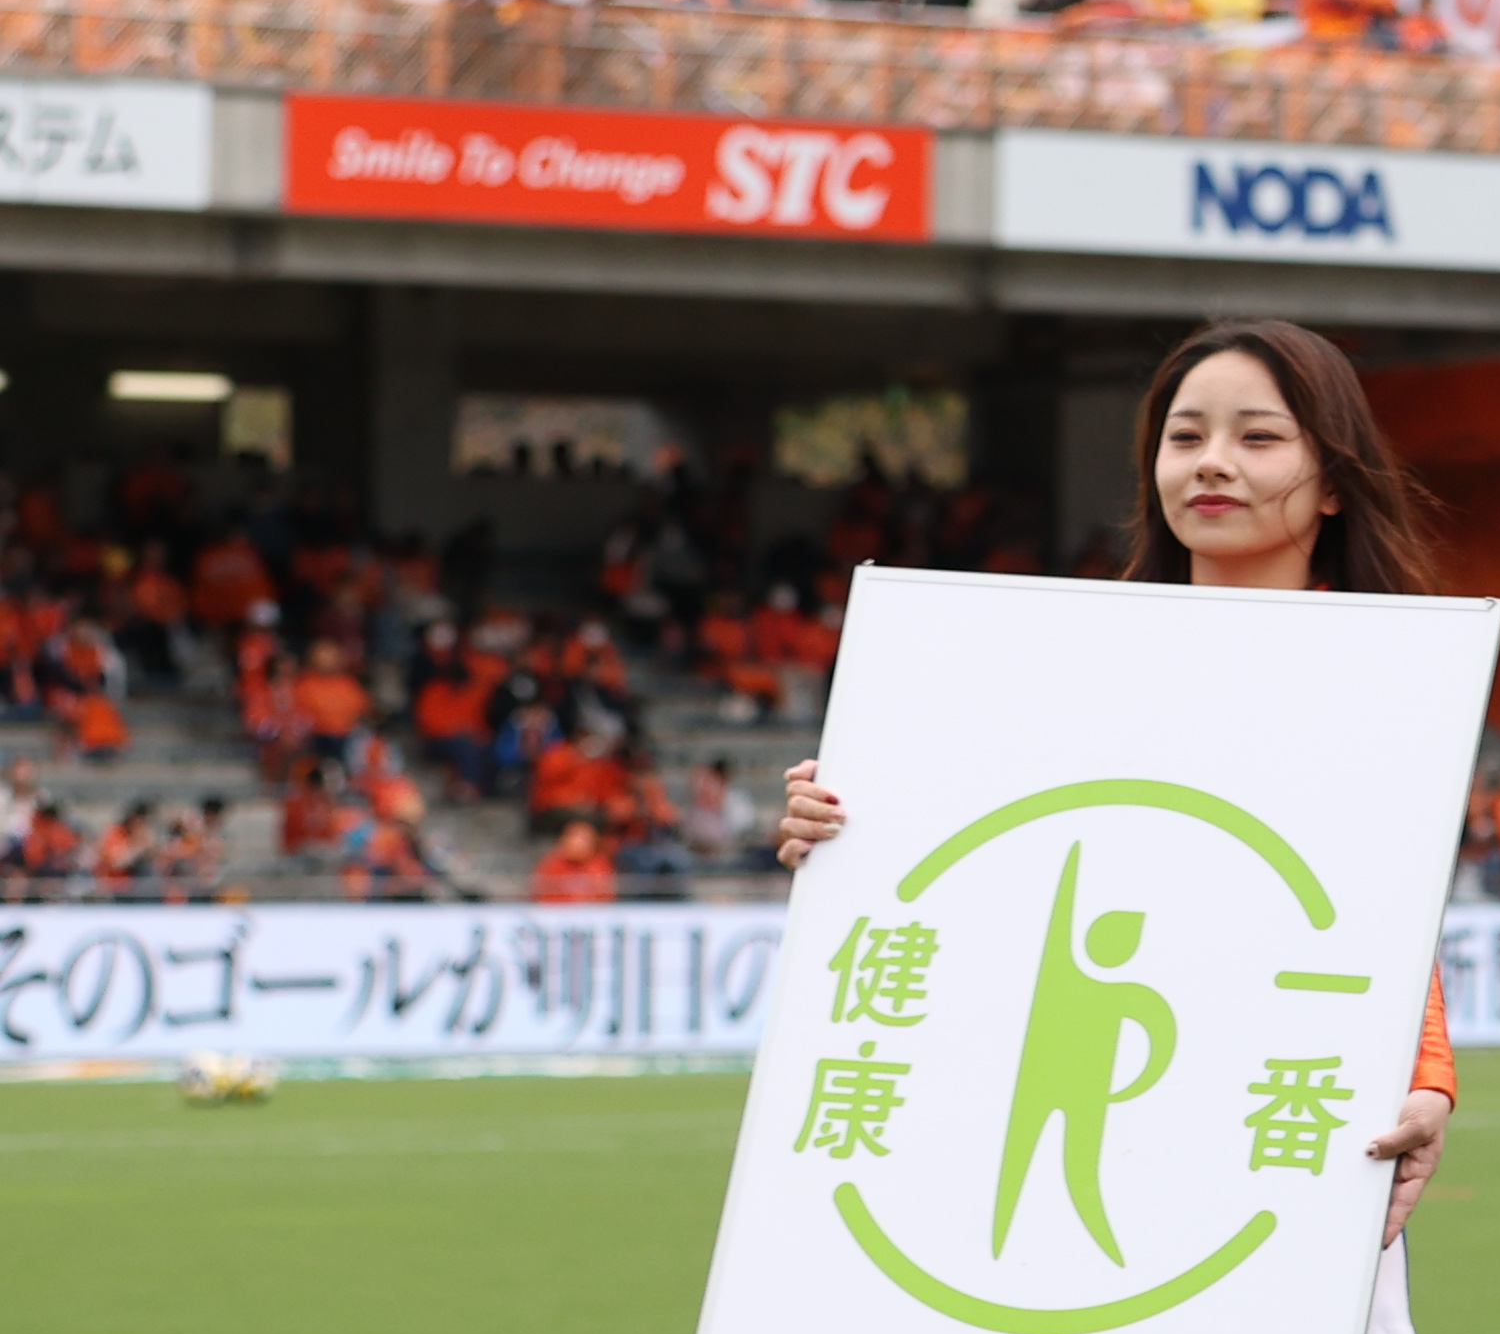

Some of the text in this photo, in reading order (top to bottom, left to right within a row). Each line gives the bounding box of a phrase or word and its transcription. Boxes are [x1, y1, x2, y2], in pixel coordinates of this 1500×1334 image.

[332, 126, 892, 229] Smile To Change STC
[1192, 159, 1397, 239] NODA
[794, 916, 940, 1159] 健康
[1243, 970, 1371, 1176] 一番
